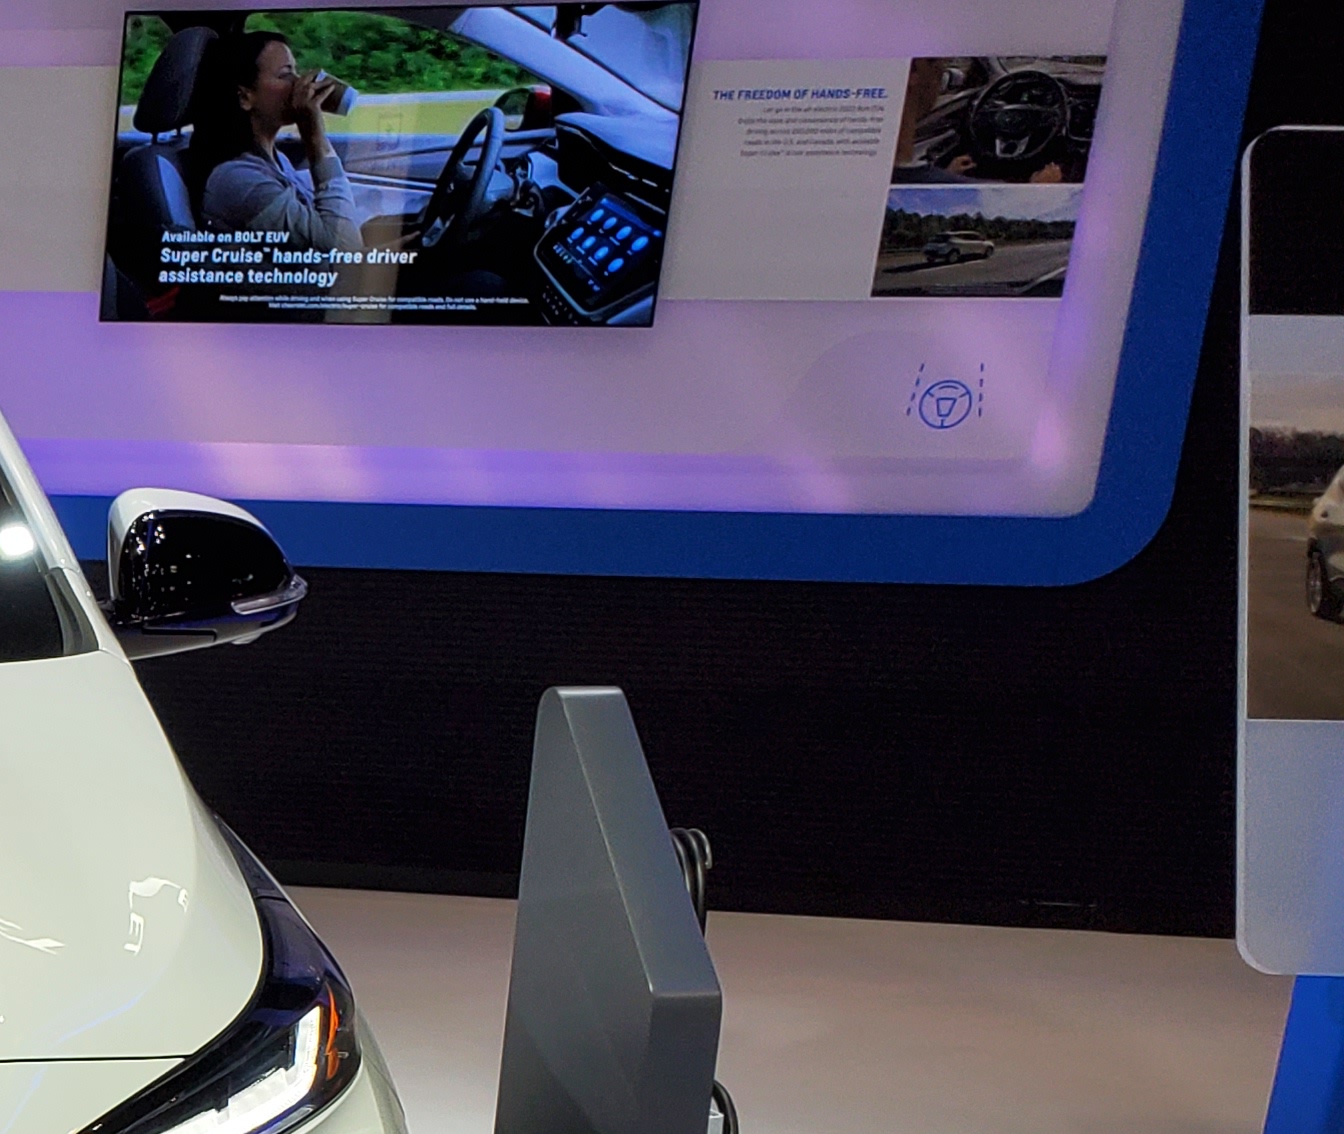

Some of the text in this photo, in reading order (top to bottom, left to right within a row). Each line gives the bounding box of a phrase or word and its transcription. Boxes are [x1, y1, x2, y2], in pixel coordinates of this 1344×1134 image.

[713, 90, 736, 100] THE
[737, 89, 791, 100] FREEDOM
[793, 89, 809, 99] OF
[161, 231, 290, 243] Available on BOLT EUV
[160, 247, 208, 266] Super
[272, 247, 363, 264] hands-free
[367, 248, 418, 264] driver
[158, 267, 339, 287] assistance technology
